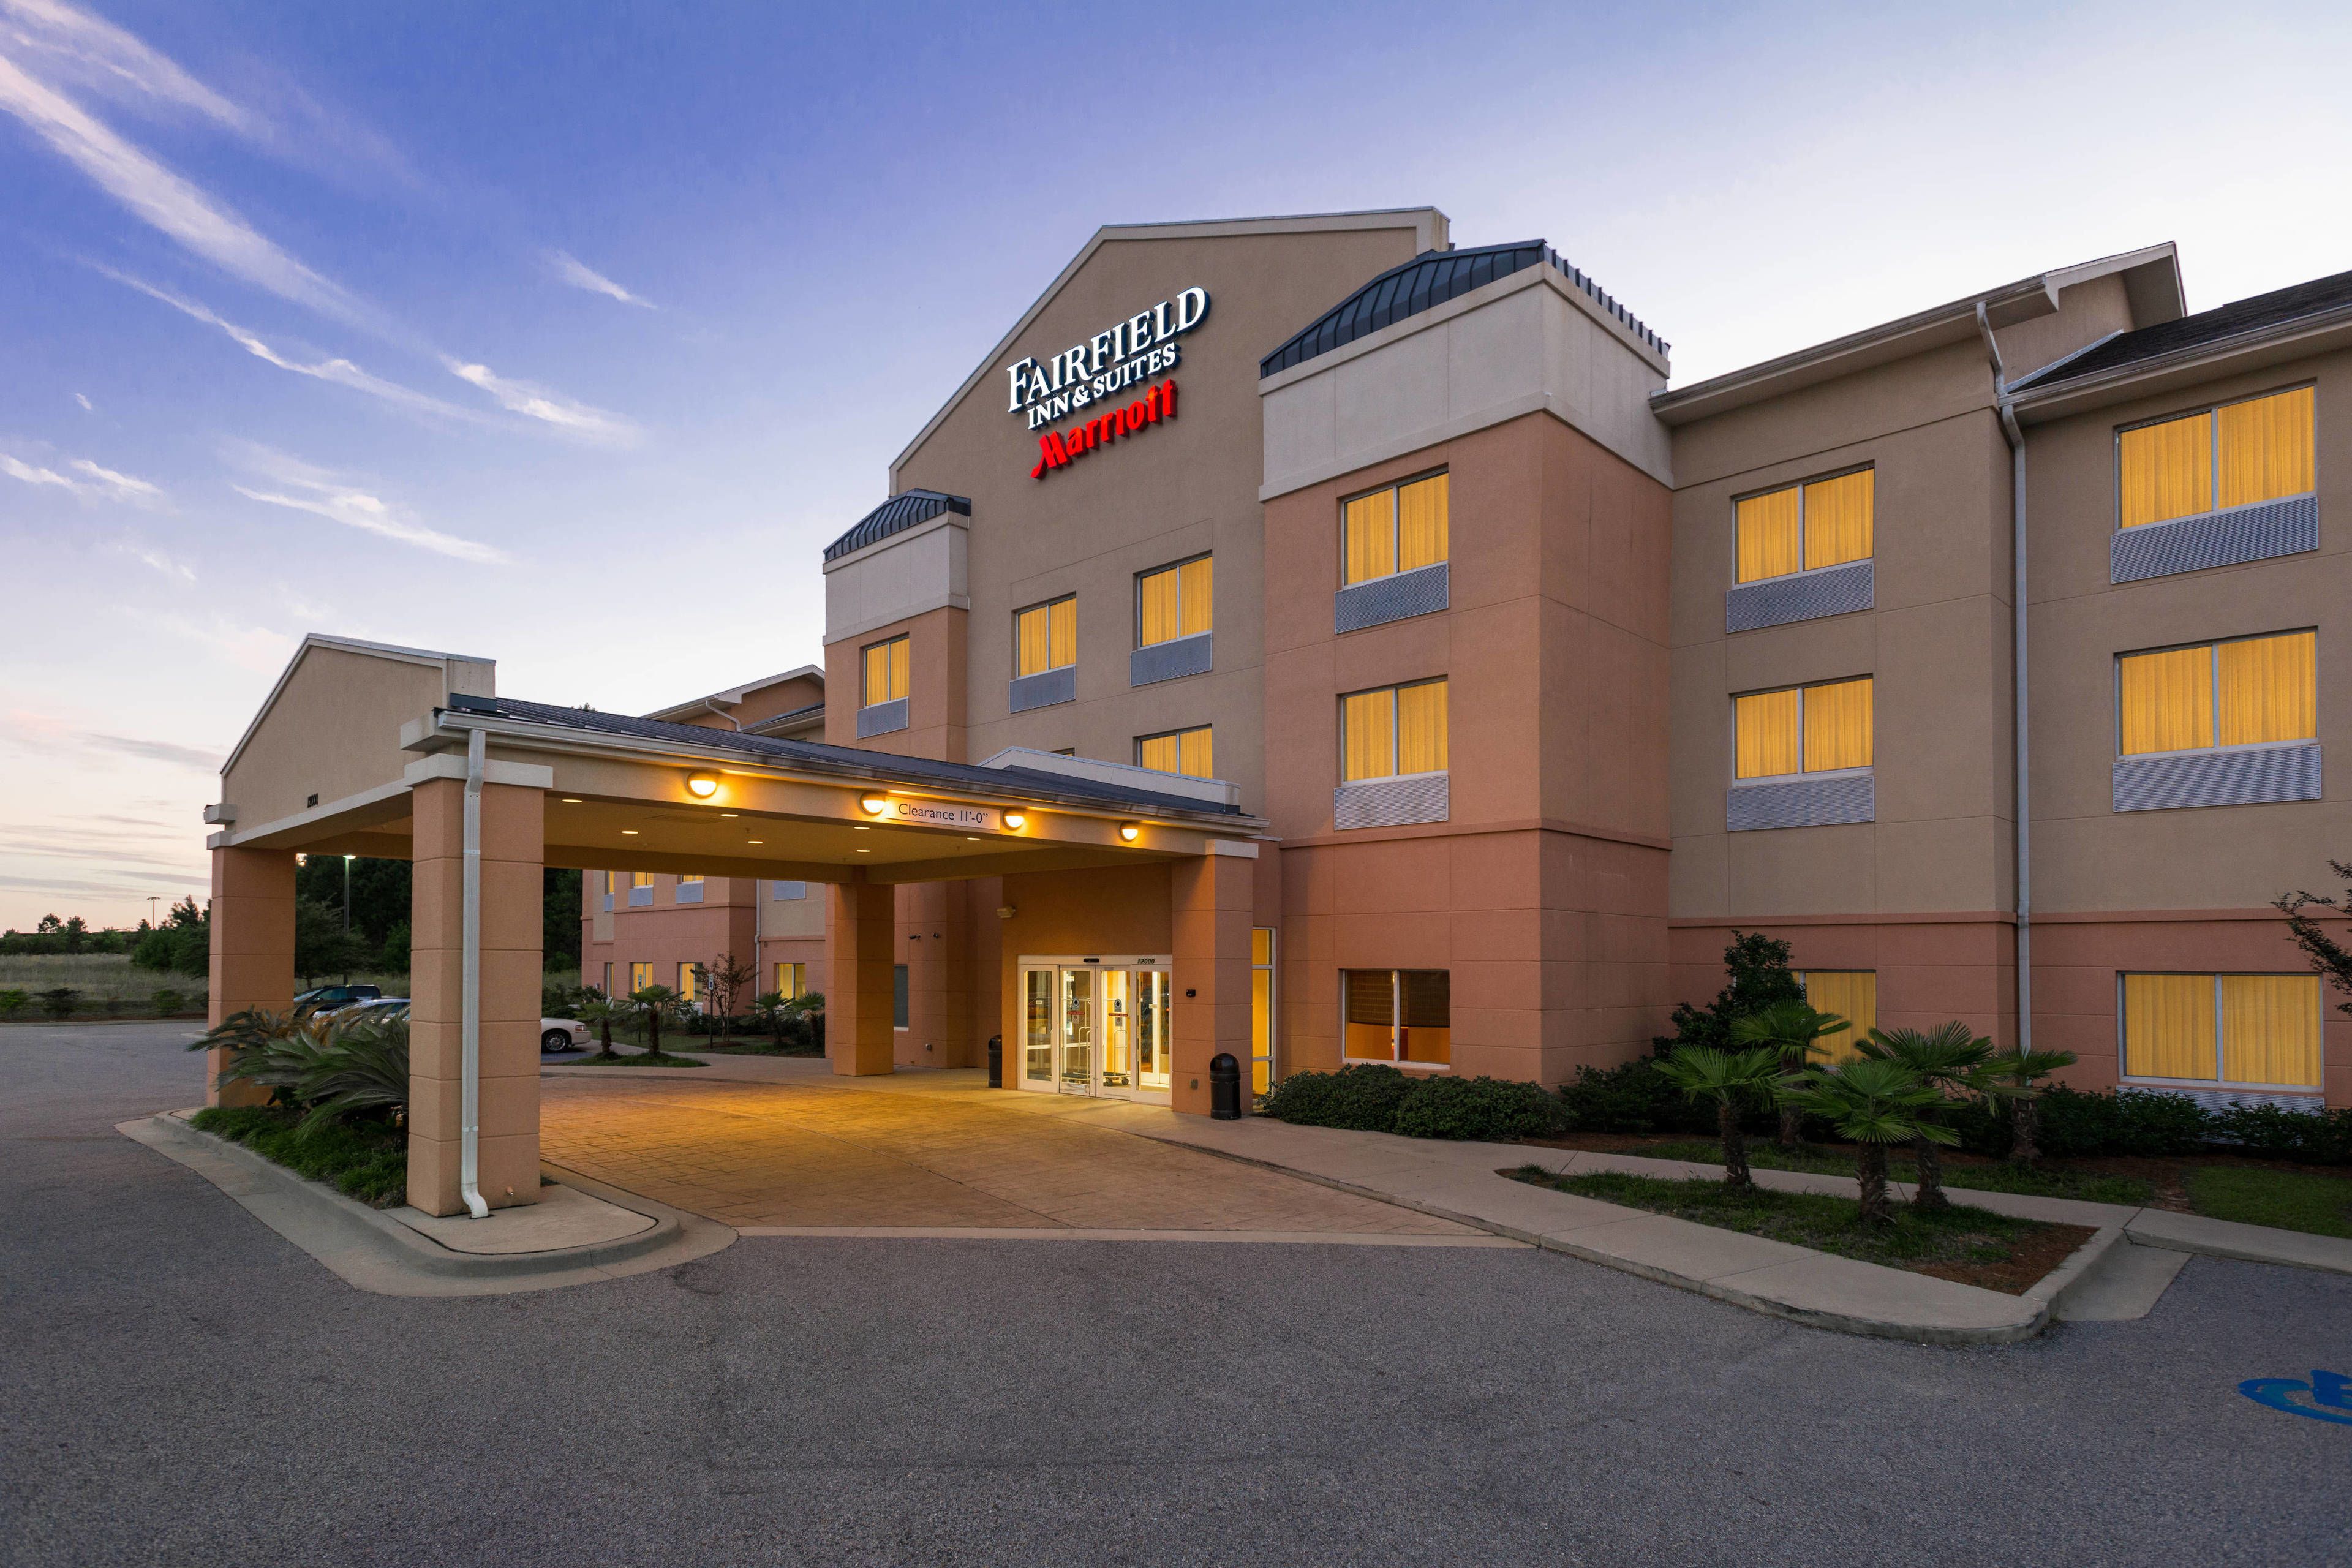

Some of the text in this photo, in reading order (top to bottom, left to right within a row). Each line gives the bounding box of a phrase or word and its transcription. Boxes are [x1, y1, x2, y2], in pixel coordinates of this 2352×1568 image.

[1006, 286, 1211, 414] FAIRFIELD
[1028, 342, 1180, 430] INN & SUITES
[1030, 378, 1178, 479] Marriott
[899, 803, 954, 820] Clearance
